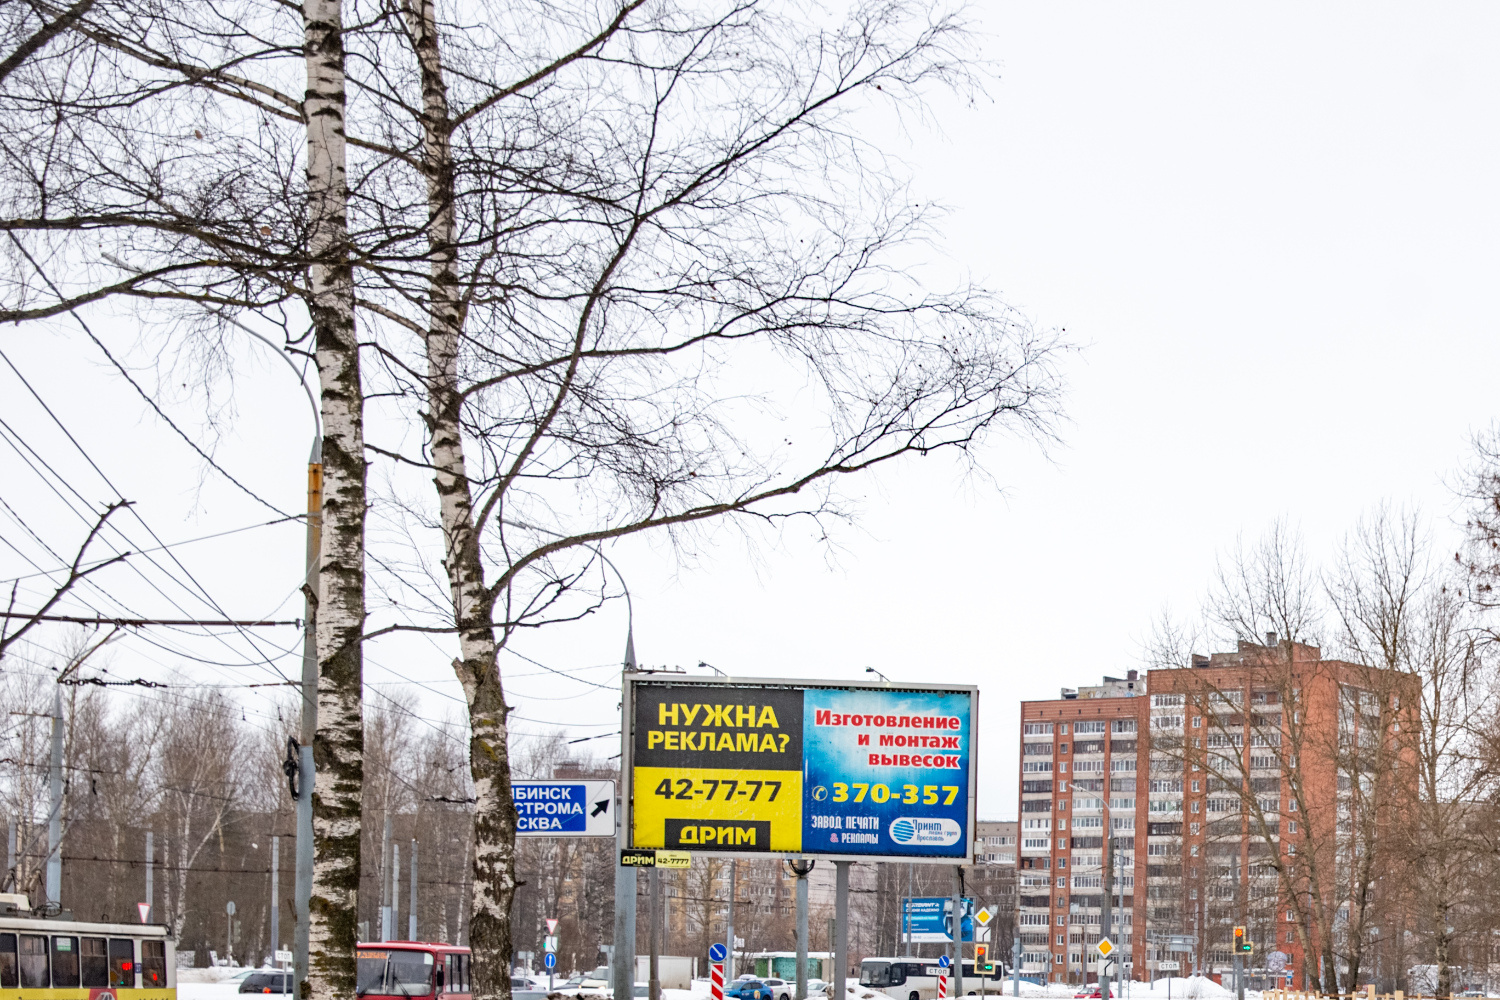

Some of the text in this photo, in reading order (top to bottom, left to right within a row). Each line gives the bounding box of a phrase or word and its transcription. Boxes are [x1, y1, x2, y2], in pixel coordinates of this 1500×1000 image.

[658, 703, 780, 729] НУЖНА
[815, 709, 960, 730] Изготовление
[647, 730, 790, 753] РЕКЛАМА?
[857, 733, 960, 749] и монтаж
[868, 753, 960, 768] вывесок
[511, 787, 572, 800] БИНСК
[654, 778, 782, 802] 42-77-77
[832, 782, 960, 806] 370-357
[516, 802, 584, 815] СТРОМА
[516, 817, 563, 830] СКВА
[811, 815, 880, 830] ЗАВОД ПЕЧАТИ
[678, 825, 757, 846] ДРИМ
[829, 832, 879, 845] & РЕКЛАМЫ
[622, 855, 655, 865] ДРИМ
